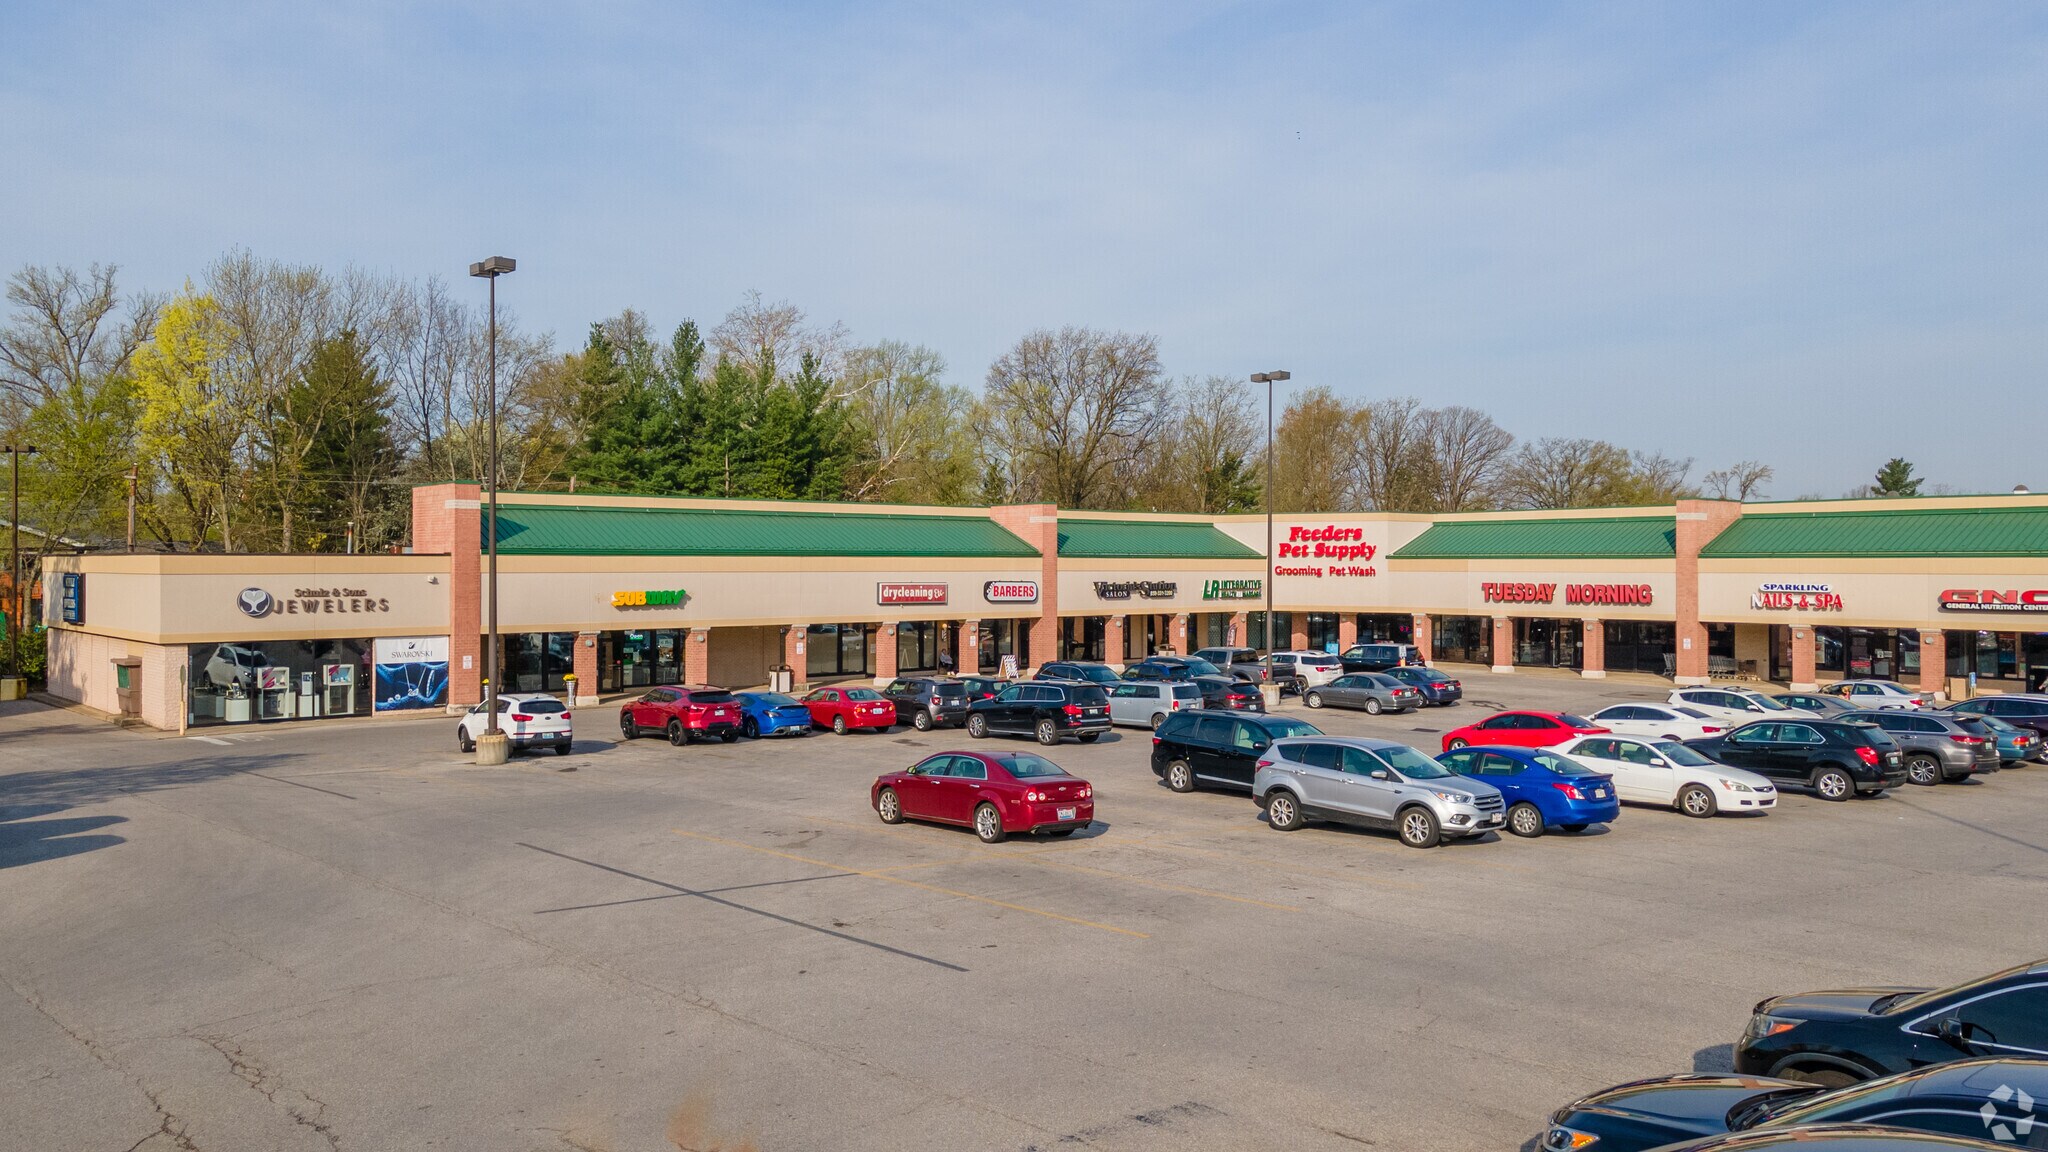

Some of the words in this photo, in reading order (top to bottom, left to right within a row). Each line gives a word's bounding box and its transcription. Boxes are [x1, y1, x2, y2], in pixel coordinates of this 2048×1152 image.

[1289, 525, 1362, 542] Feeders
[1278, 543, 1309, 558] Pet
[1314, 542, 1376, 561] Supply
[1275, 565, 1323, 577] Grooming
[1329, 566, 1346, 577] Pet
[1348, 566, 1376, 577] Wash
[331, 588, 341, 598] &
[342, 588, 367, 597] Sons
[883, 586, 933, 601] drycleaning
[993, 585, 1035, 598] BARBERS
[1482, 582, 1557, 603] TUESDAY
[1566, 583, 1653, 604] MORNING
[1763, 583, 1829, 592] SPARKLING
[611, 589, 686, 607] SUBWAY
[1751, 592, 1793, 608] NAILS
[1799, 593, 1809, 609] &
[1814, 593, 1843, 609] SPA
[1940, 589, 2048, 605] GNC
[273, 598, 390, 615] JEWELERS
[1946, 602, 1980, 610] GENERAL
[1981, 603, 2021, 611] NUTRITION
[391, 650, 433, 659] SWAROVSKI
